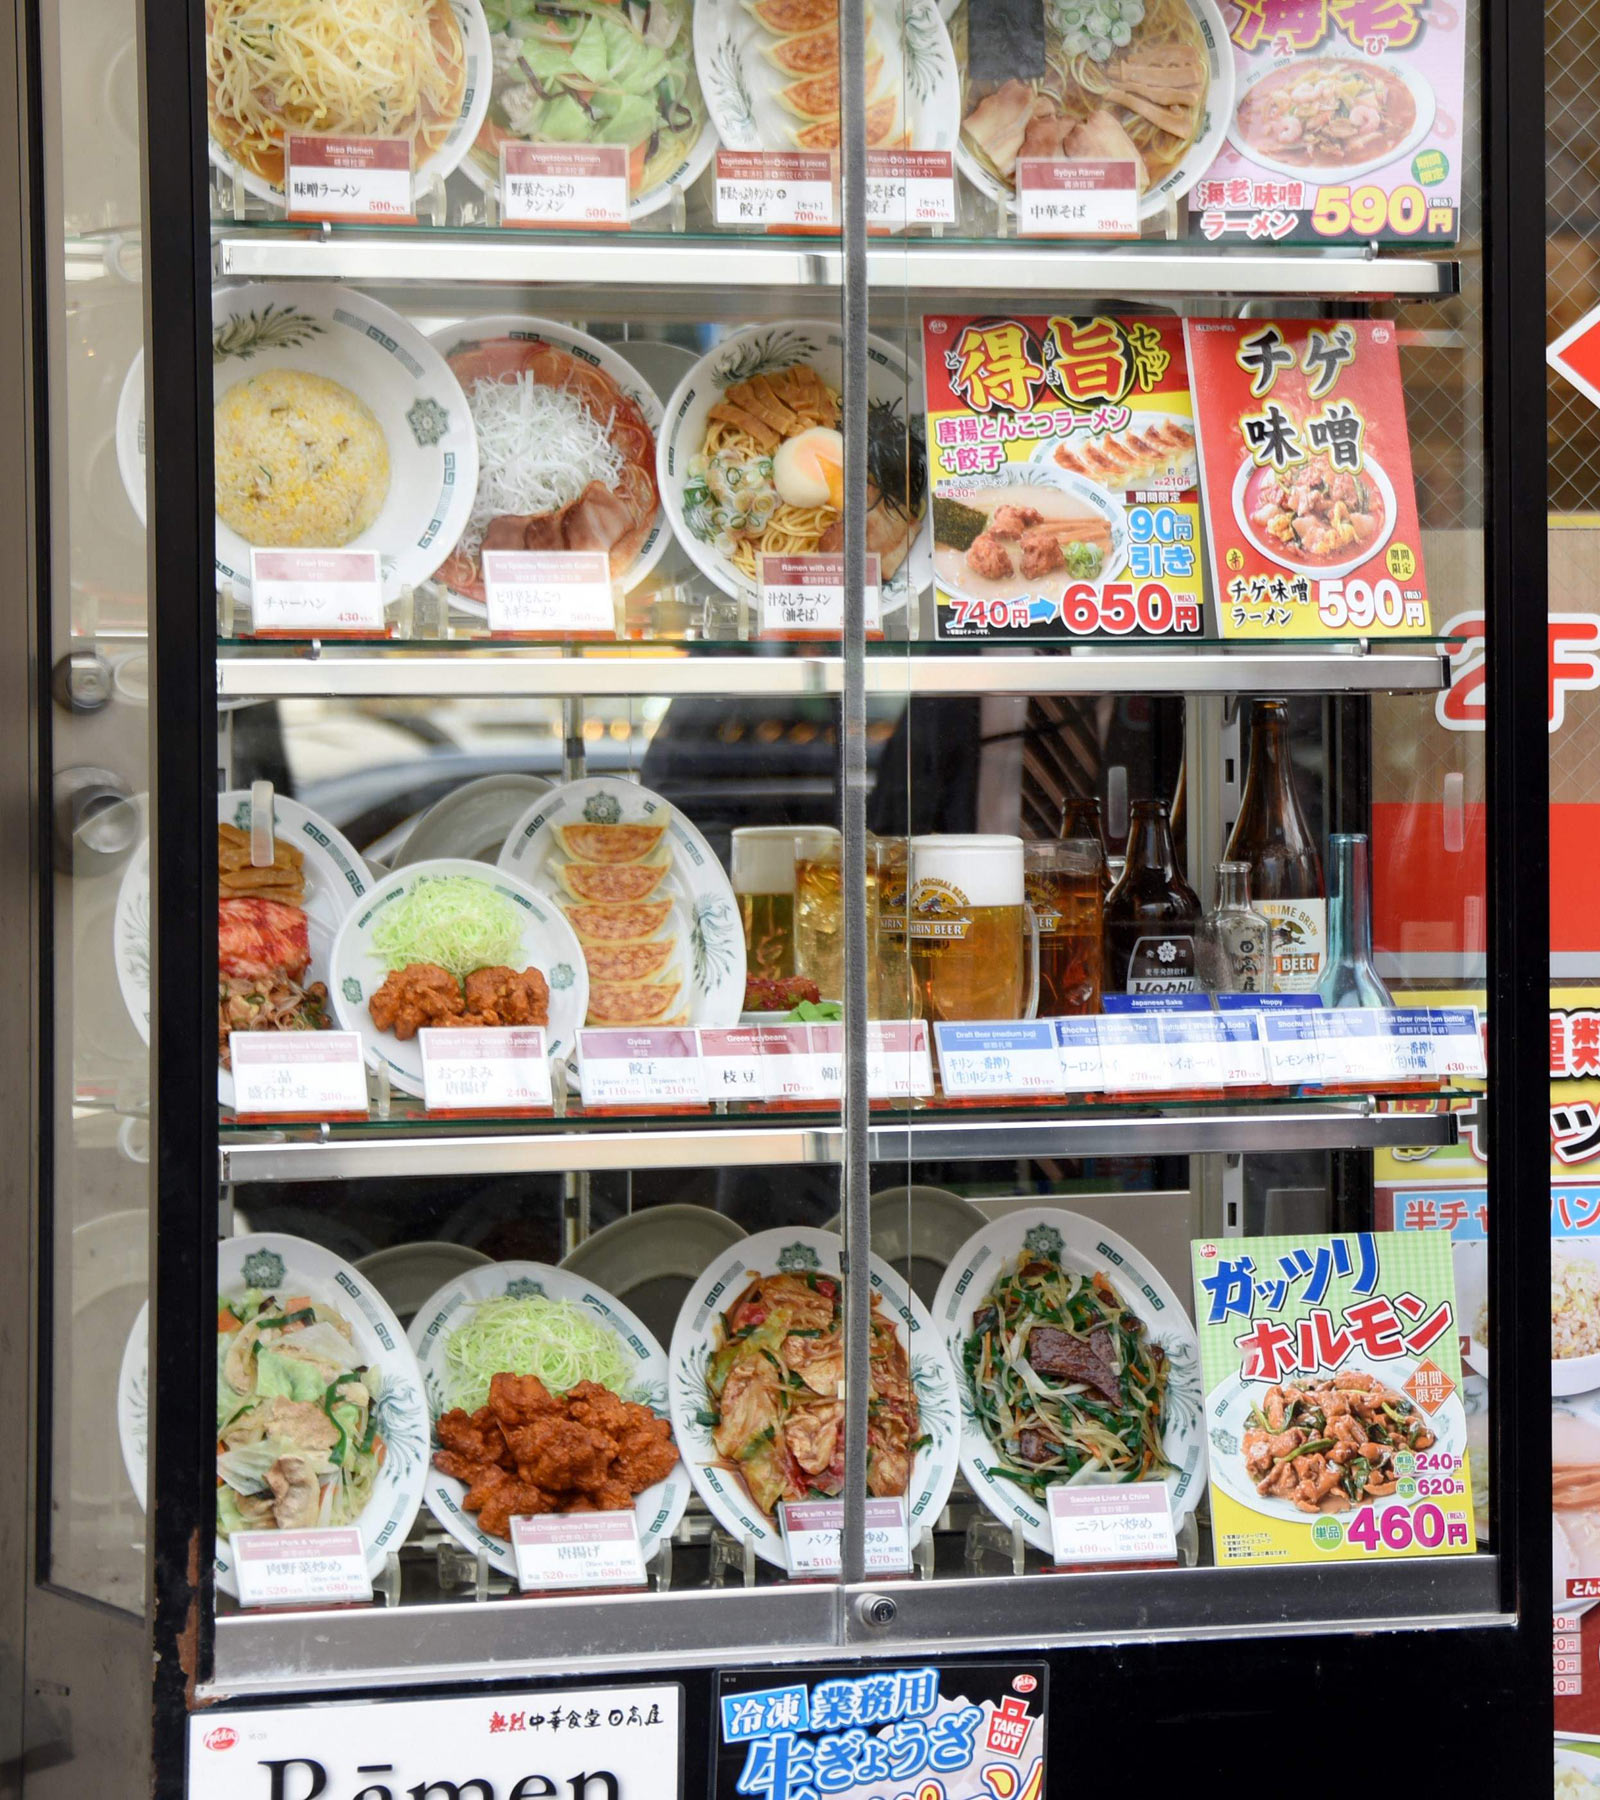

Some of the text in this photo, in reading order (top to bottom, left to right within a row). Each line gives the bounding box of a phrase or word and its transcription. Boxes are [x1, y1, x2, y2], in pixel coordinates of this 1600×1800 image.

[1030, 204, 1087, 219] 中華そば
[1202, 213, 1299, 239] ラーメン
[1240, 326, 1353, 396] チゲ
[936, 406, 1129, 443] 唐揚とんこつラーメン
[1129, 545, 1194, 577] 引き
[768, 591, 832, 607] 汁なしラーメン
[1233, 606, 1292, 626] ラーメン
[934, 924, 962, 935] BEER
[1201, 1233, 1380, 1324] ガッツリ
[1236, 1294, 1453, 1382] ホルモン
[731, 1669, 938, 1736] 冷凍 業務用
[993, 1716, 1025, 1737] TAKE
[991, 1732, 1020, 1750] OUT
